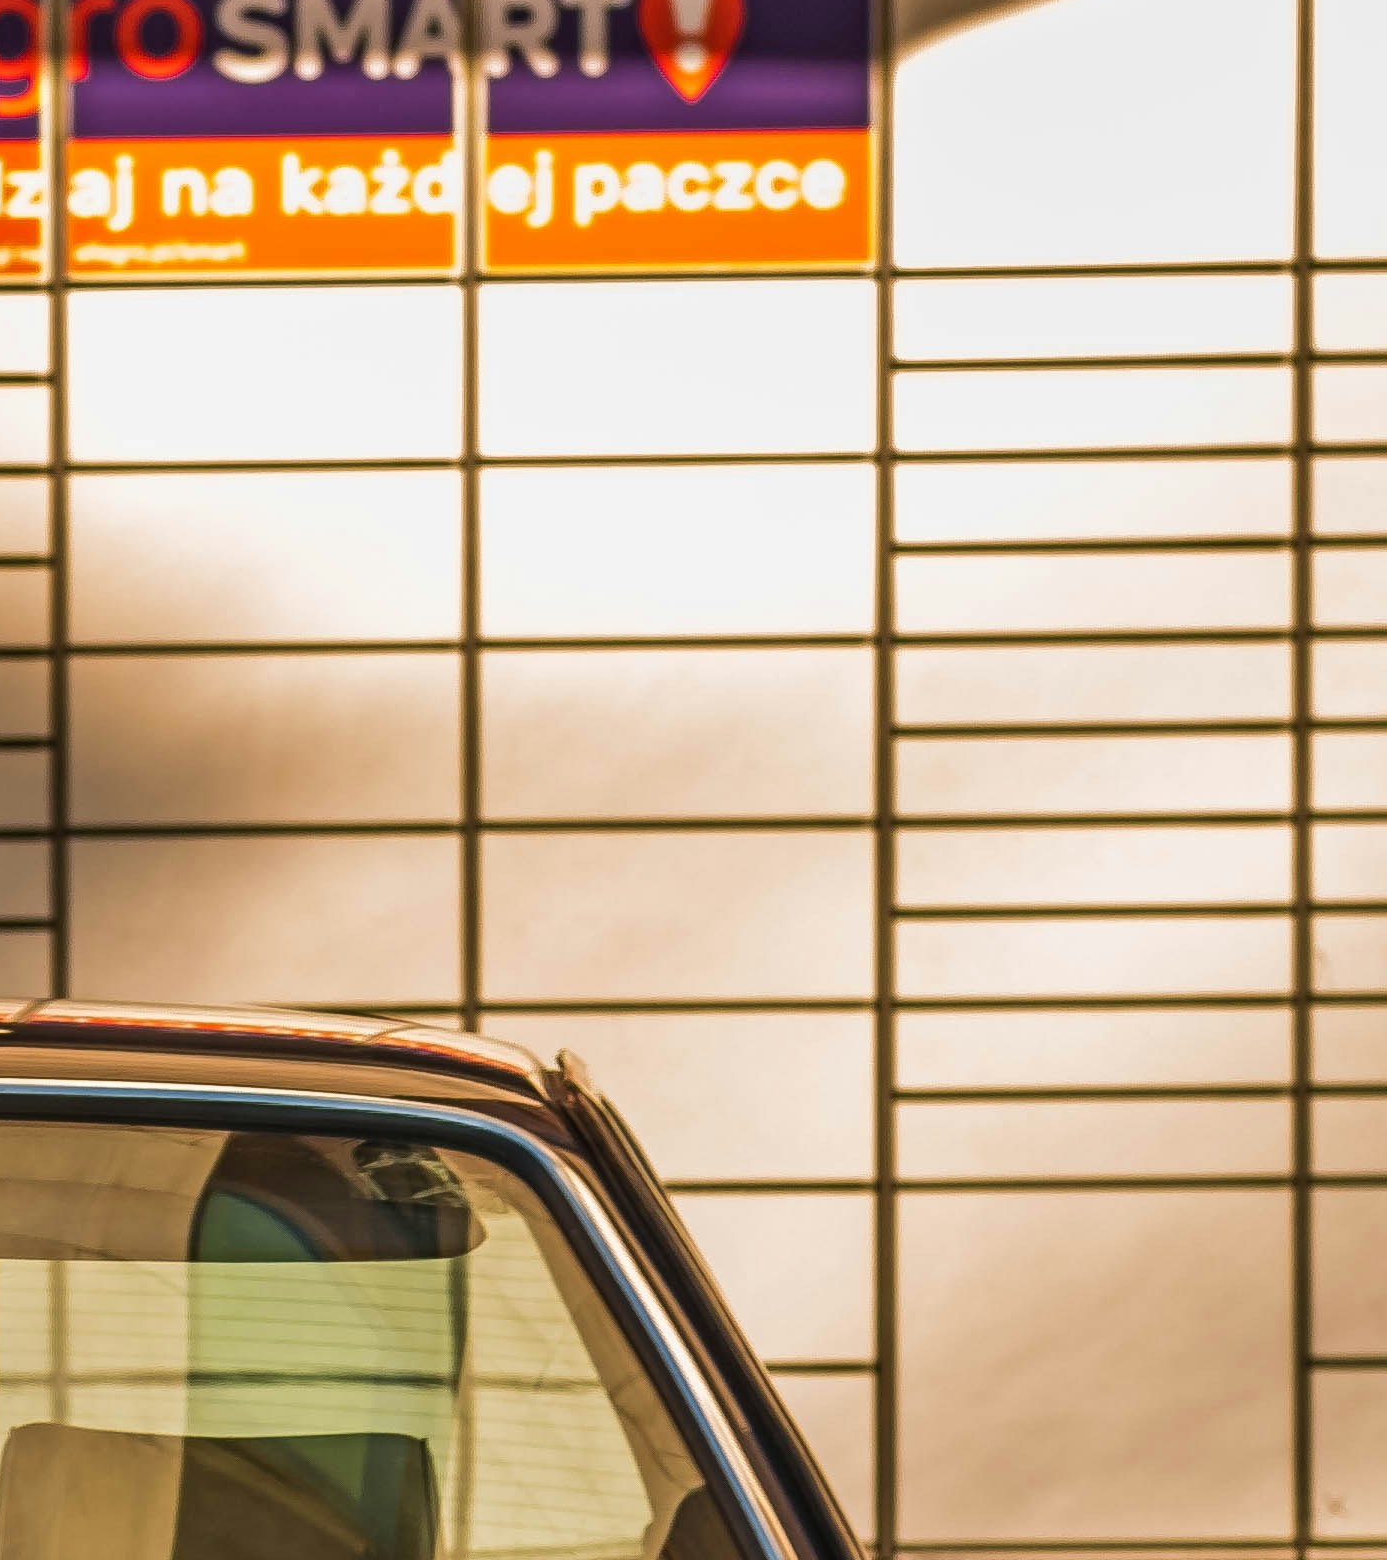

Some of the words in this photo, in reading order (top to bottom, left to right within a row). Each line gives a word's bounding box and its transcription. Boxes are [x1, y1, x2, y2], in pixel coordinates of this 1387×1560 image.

[161, 166, 255, 217] na
[282, 149, 553, 229] każdej
[573, 158, 847, 228] paczce
